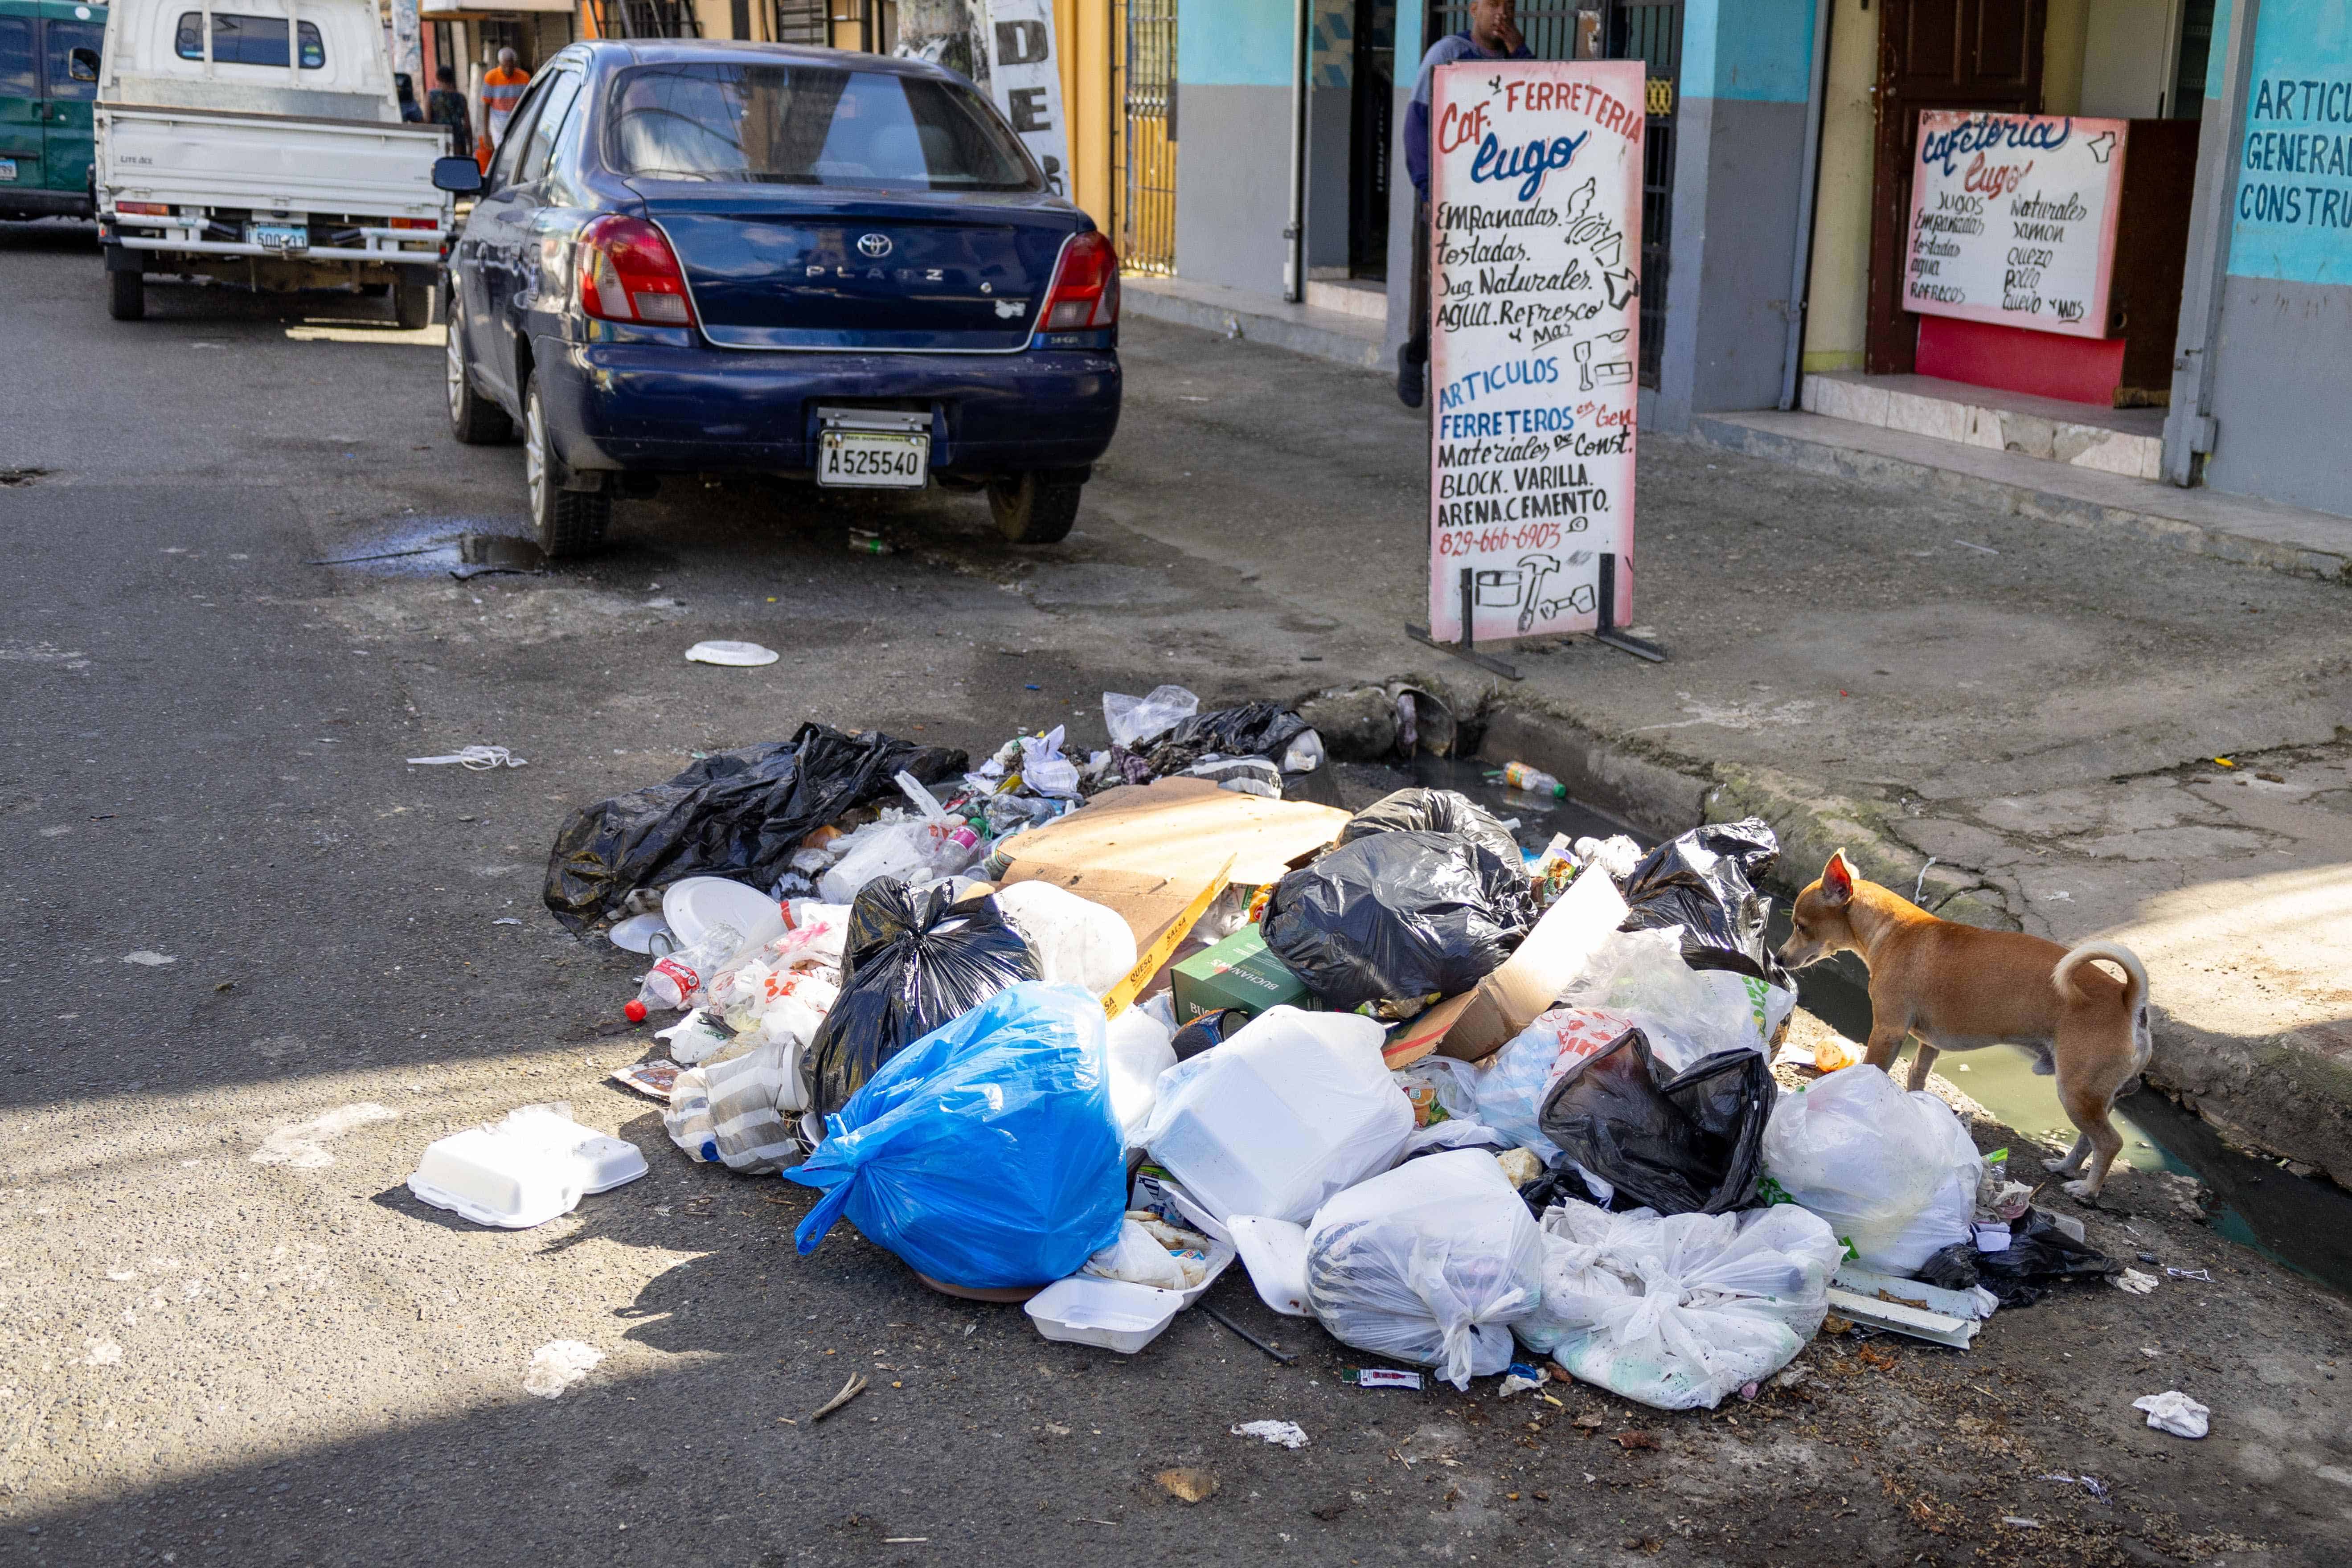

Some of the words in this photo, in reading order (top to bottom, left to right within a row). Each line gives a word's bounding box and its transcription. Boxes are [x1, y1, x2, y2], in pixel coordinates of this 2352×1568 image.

[1505, 80, 1644, 143] FERRETERIA
[1439, 356, 1559, 413] ARTICULOS
[1440, 406, 1574, 440] FERRETEROS
[828, 450, 918, 475] A525540
[1440, 469, 1508, 499] BLOCK.
[1514, 463, 1594, 491] VARILLA.
[1439, 522, 1561, 557] 829-666-6903
[1166, 916, 1186, 942] SALSA
[1130, 953, 1152, 983] QUESO
